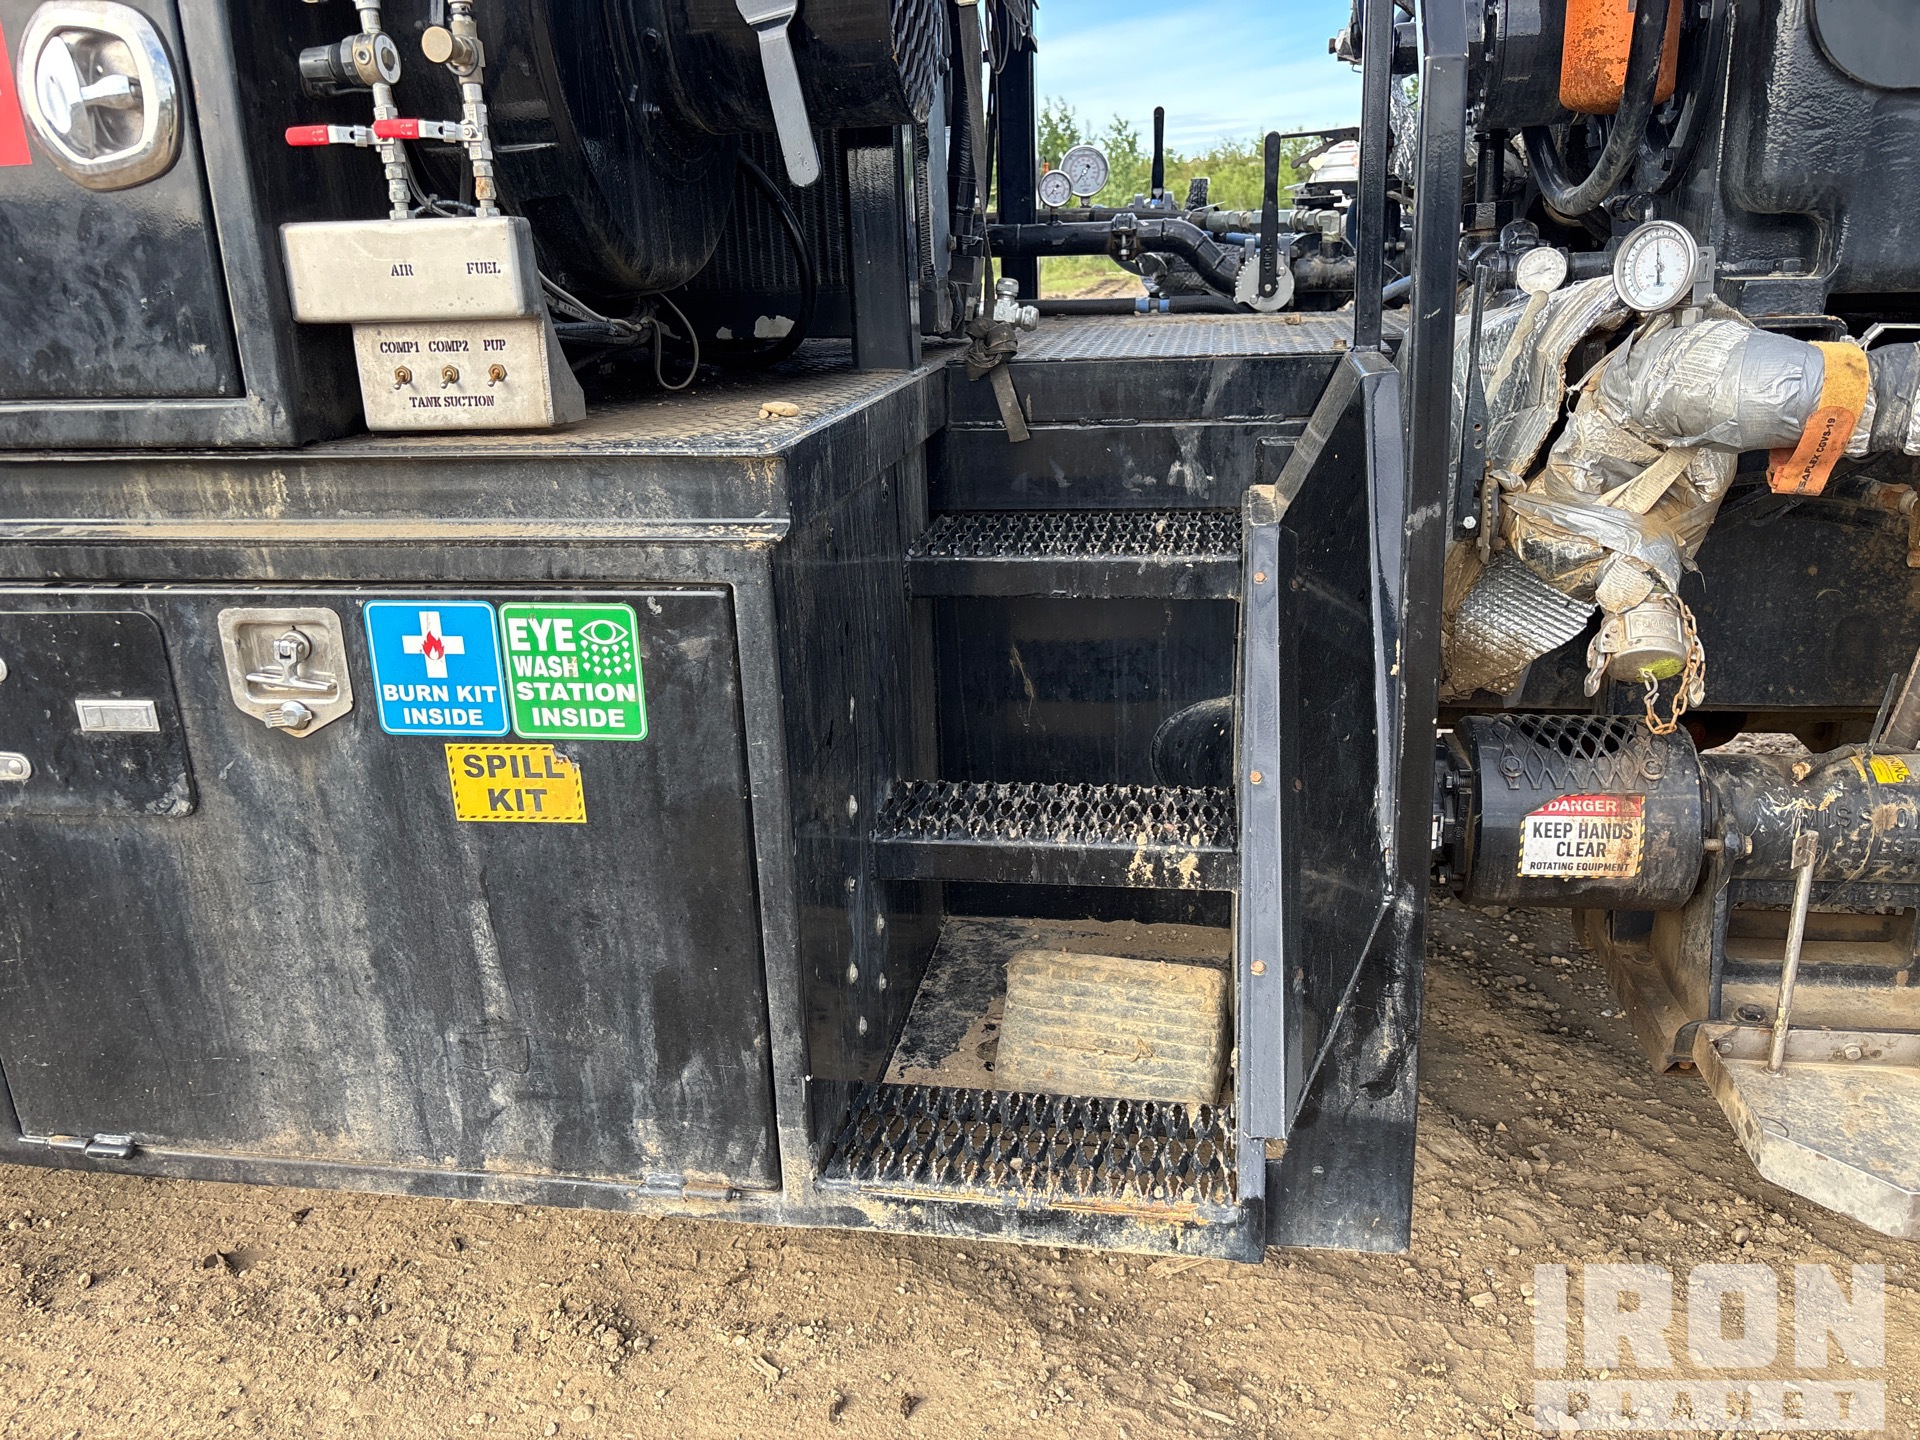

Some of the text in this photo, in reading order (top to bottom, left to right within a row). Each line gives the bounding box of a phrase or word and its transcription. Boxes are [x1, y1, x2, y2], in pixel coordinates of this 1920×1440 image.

[391, 262, 501, 276] AIR FUEL
[380, 339, 506, 353] COMP1 COMP2 PUP
[409, 395, 495, 408] TANK SUCTION
[507, 618, 576, 651] EYE
[512, 655, 579, 678] WASH
[383, 684, 497, 703] BURN KIT
[516, 682, 637, 702] STATION
[403, 708, 484, 726] INSIDE
[532, 707, 626, 728] INSIDE
[463, 754, 565, 779] SPILL
[487, 788, 548, 812] KIT
[1548, 800, 1617, 812] DANGER
[1532, 822, 1633, 839] KEEP HANDS
[1556, 841, 1607, 857] CLEAR
[1529, 861, 1630, 872] ROTATING EQUIPMENT
